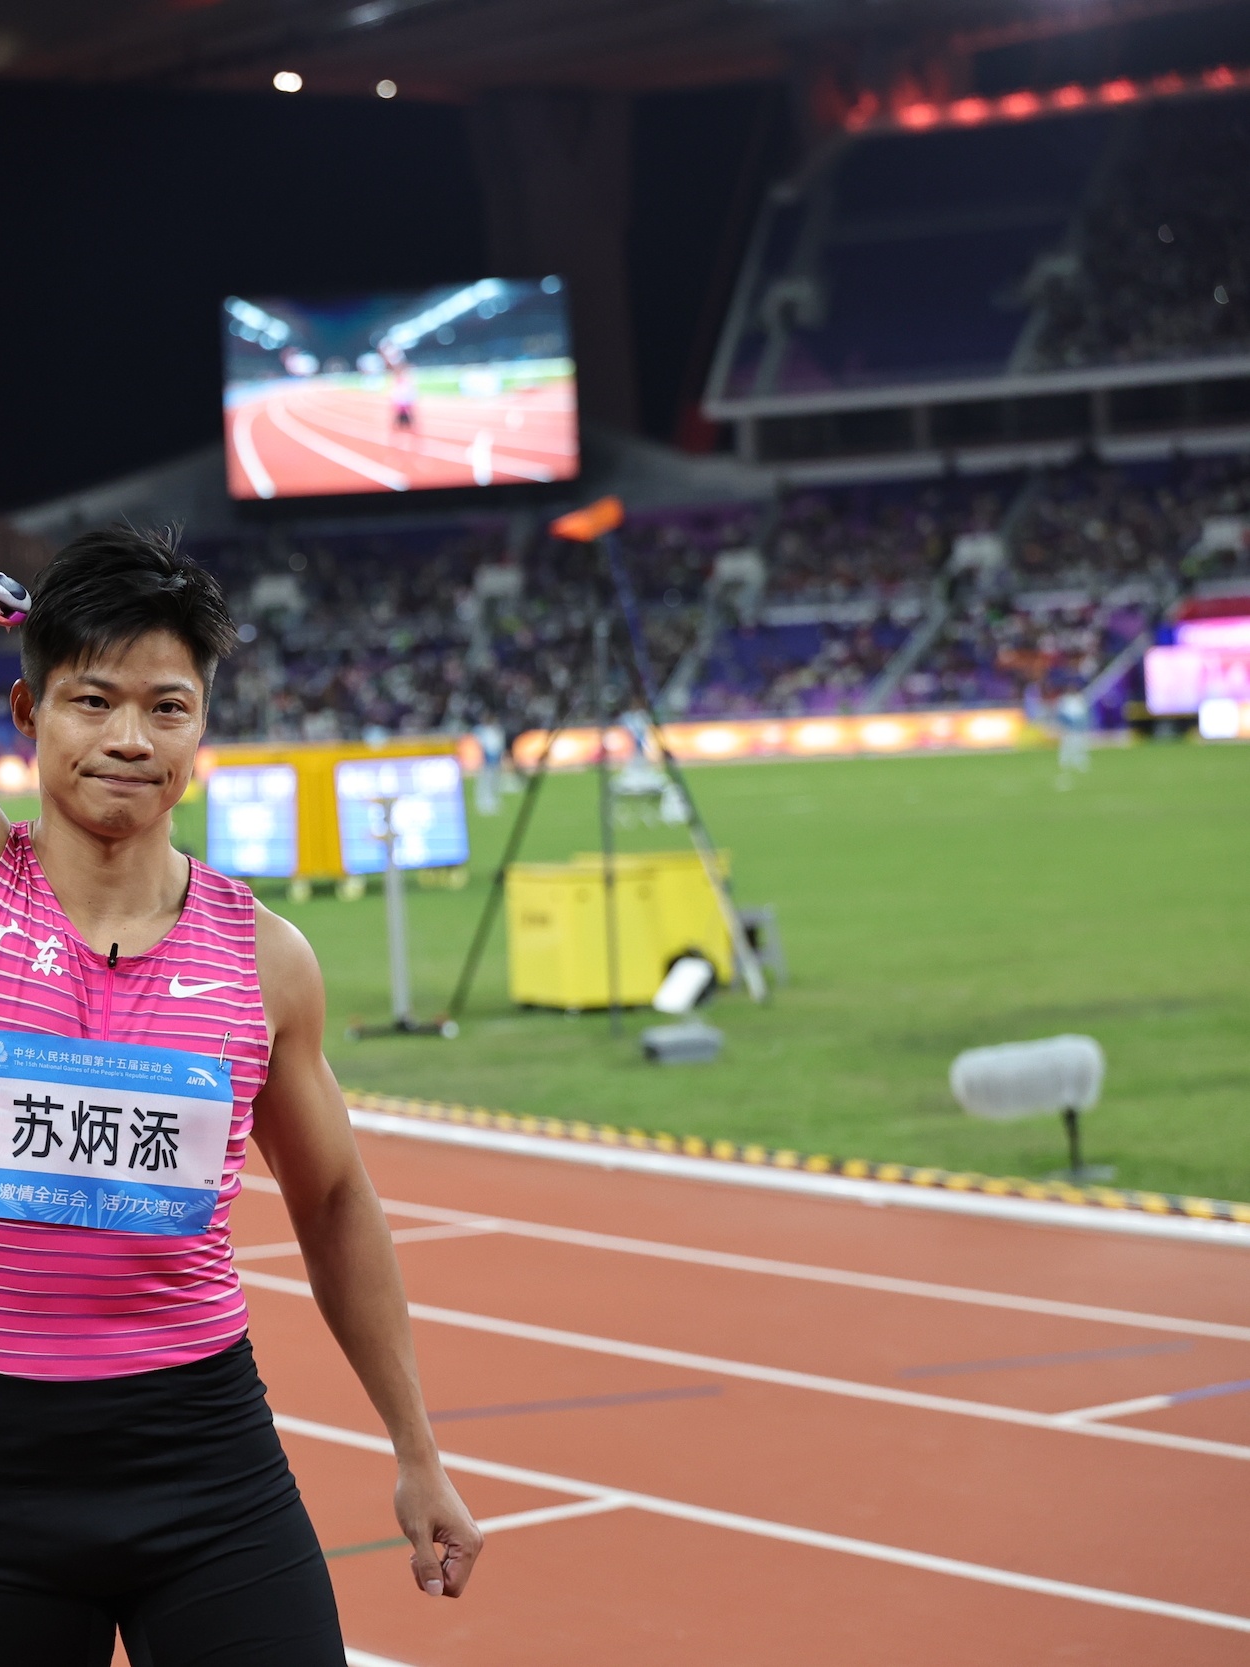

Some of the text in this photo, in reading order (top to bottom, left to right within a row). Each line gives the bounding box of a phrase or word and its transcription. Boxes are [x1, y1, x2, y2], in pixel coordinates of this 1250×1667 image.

[13, 1047, 173, 1075] 中华人民共和国第十五届运动会
[38, 1062, 63, 1071] National
[63, 1065, 83, 1073] Games
[100, 1069, 124, 1077] People's
[124, 1072, 149, 1080] Republic
[186, 1076, 207, 1086] ANTA
[12, 1094, 180, 1172] 苏炳添
